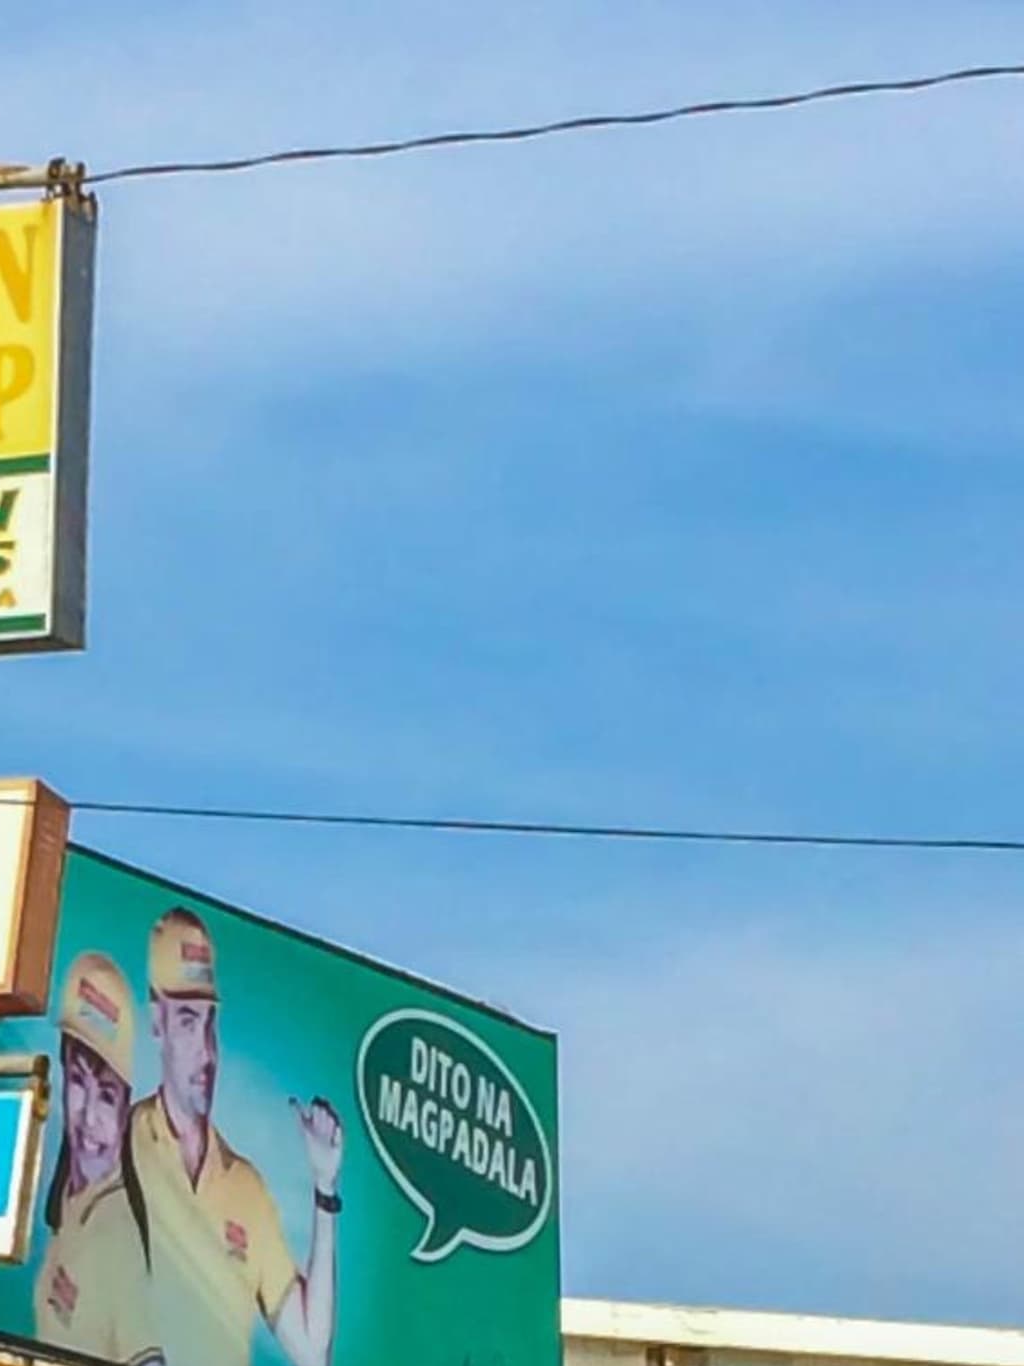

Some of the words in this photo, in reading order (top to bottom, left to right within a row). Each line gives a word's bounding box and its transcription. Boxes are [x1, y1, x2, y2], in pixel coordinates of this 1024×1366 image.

[378, 1074, 539, 1207] MAGPADALA
[410, 1036, 472, 1113] DITO
[475, 1074, 515, 1138] NA
